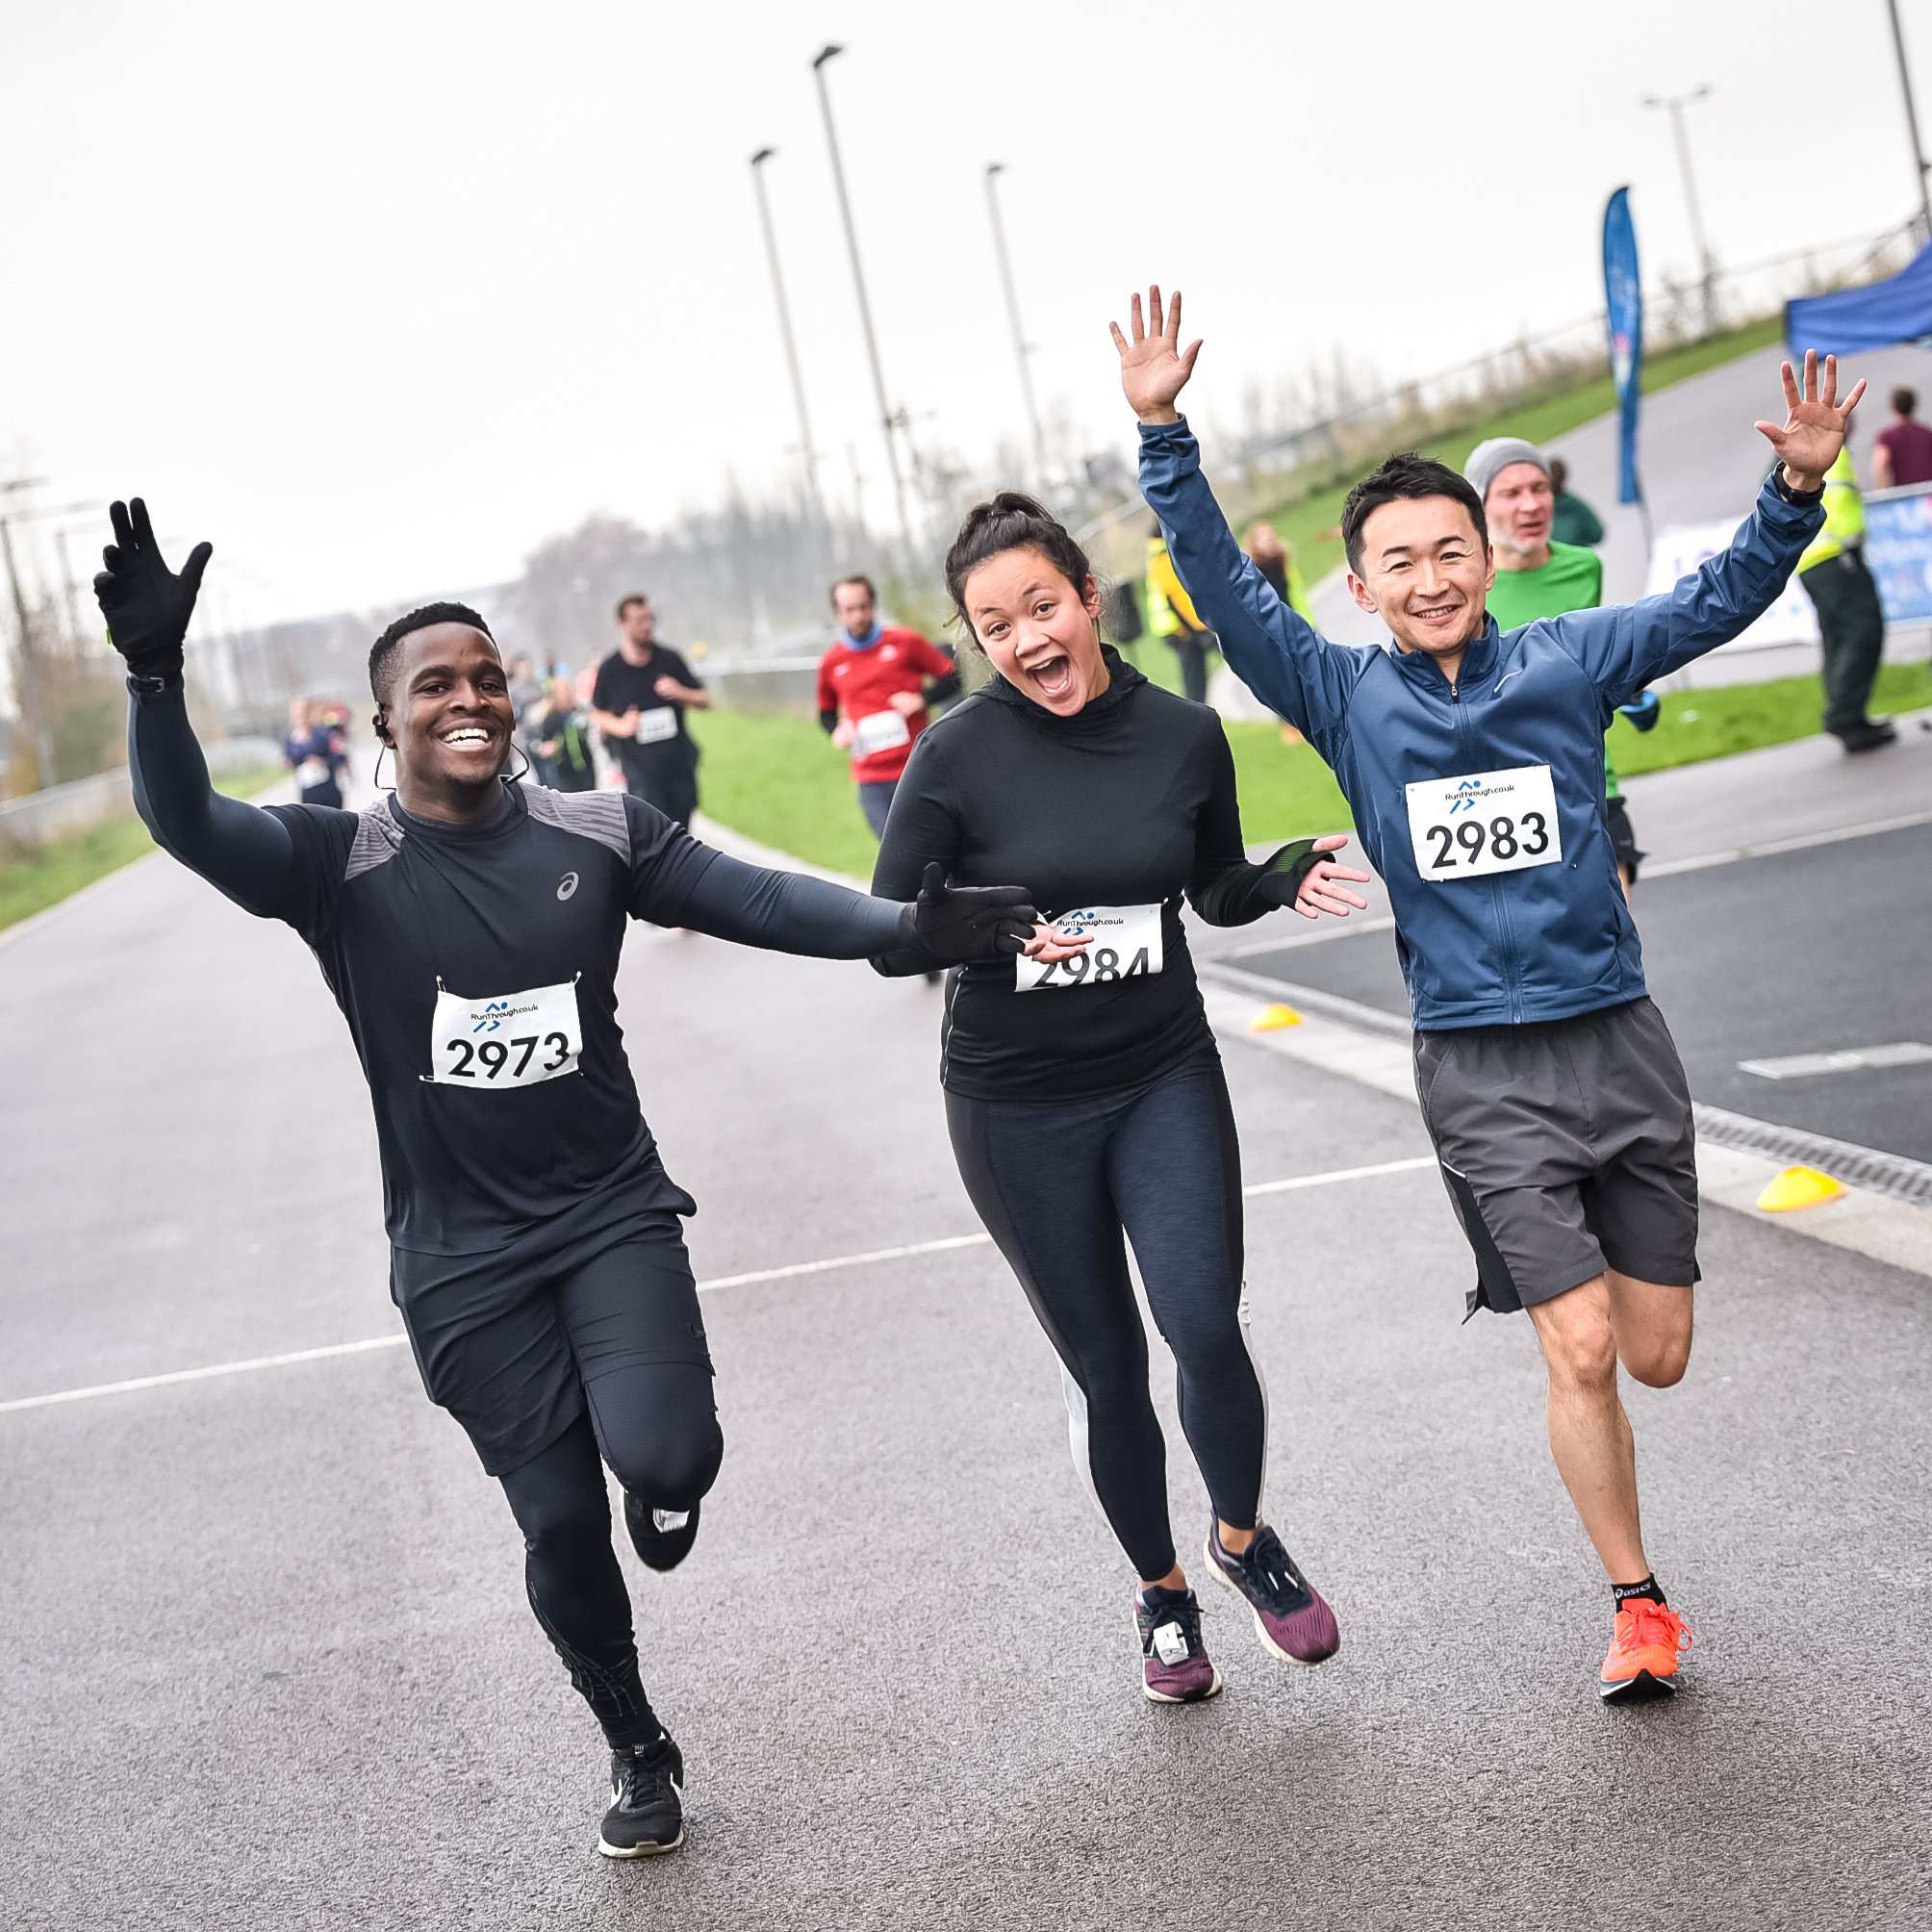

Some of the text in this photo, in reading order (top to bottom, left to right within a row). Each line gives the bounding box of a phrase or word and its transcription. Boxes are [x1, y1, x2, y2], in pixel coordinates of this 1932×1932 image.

[1445, 784, 1515, 801] RunThrough.co.uk
[1426, 812, 1549, 869] 2983
[470, 1003, 539, 1021] RunThrough.co.uk
[446, 1031, 571, 1080] 2973
